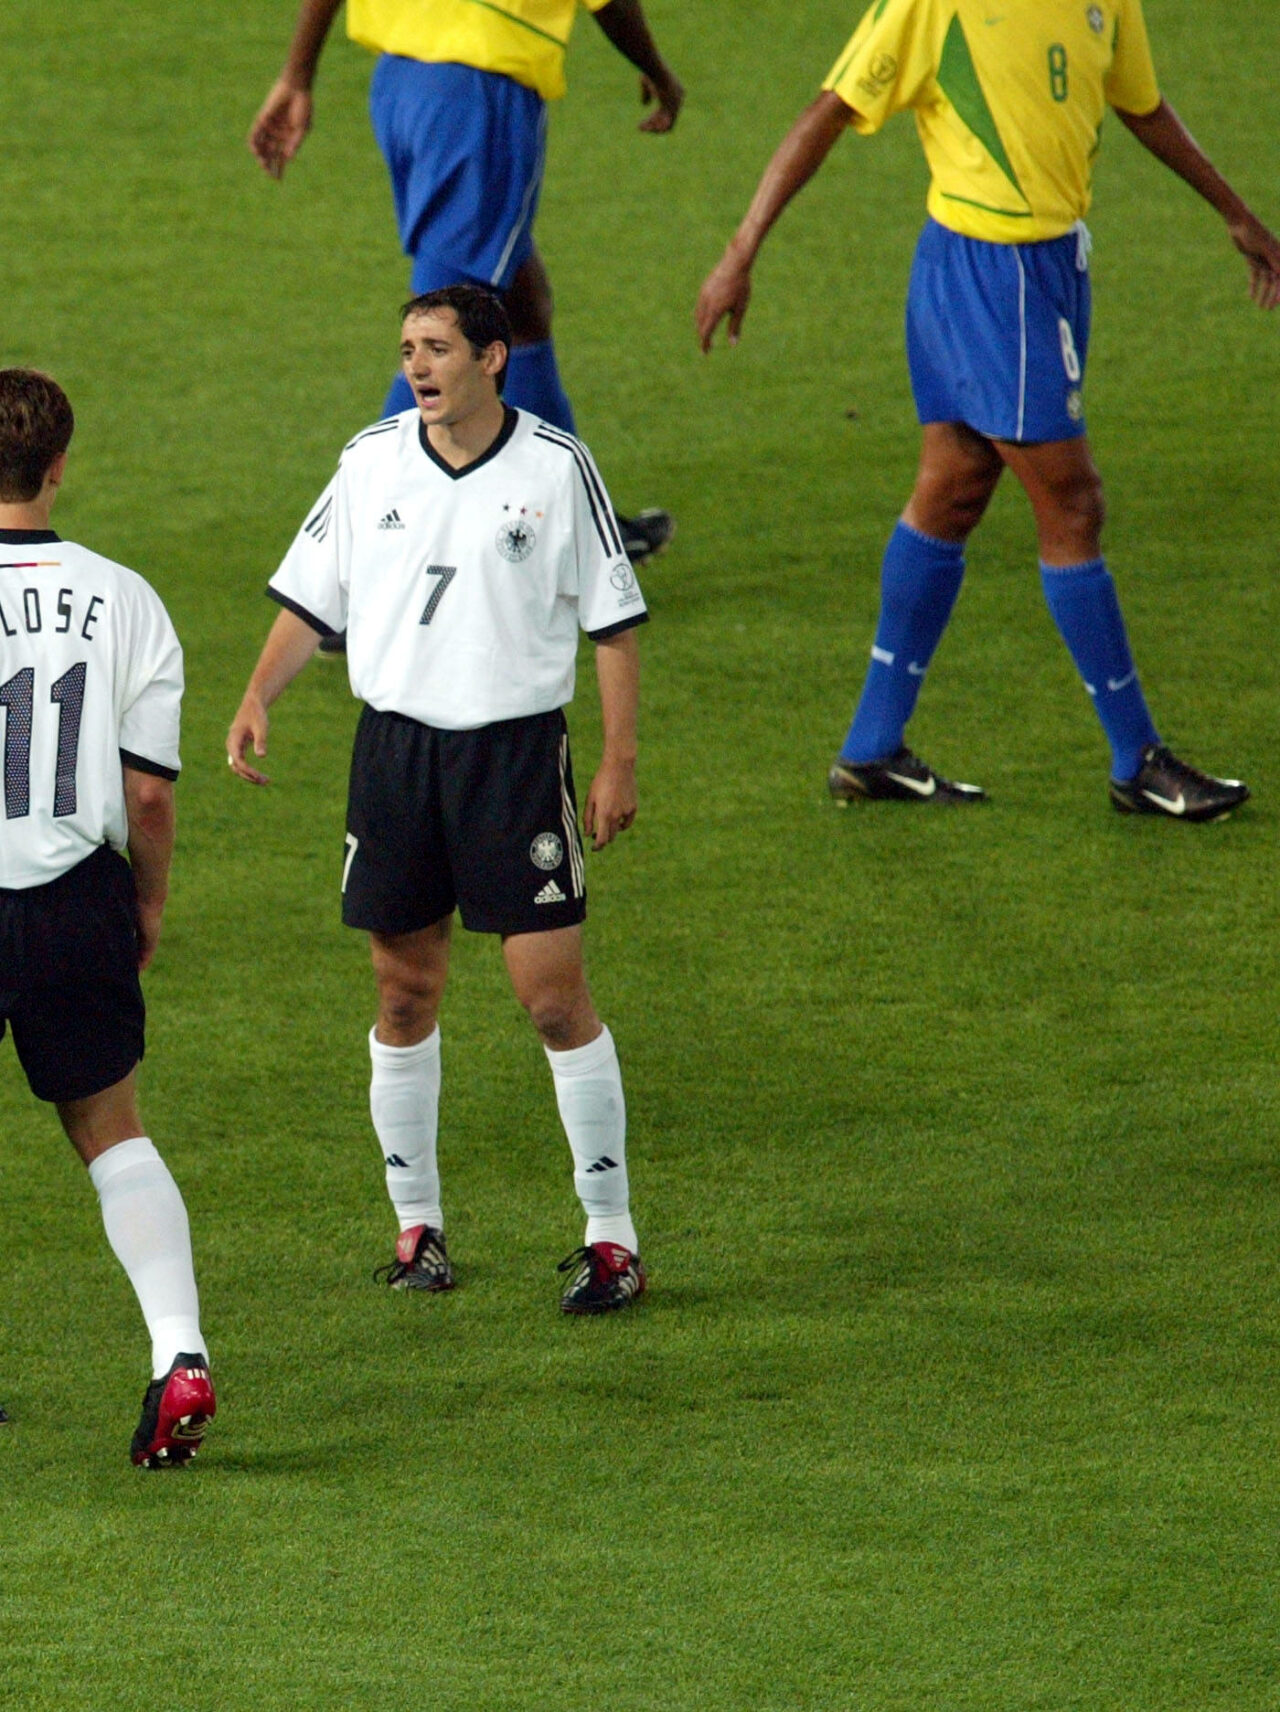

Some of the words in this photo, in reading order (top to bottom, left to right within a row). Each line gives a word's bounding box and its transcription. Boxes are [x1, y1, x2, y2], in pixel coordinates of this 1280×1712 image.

[1048, 42, 1067, 102] 8
[1059, 317, 1080, 381] 8
[419, 565, 457, 625] 7
[534, 893, 566, 904] adidas
